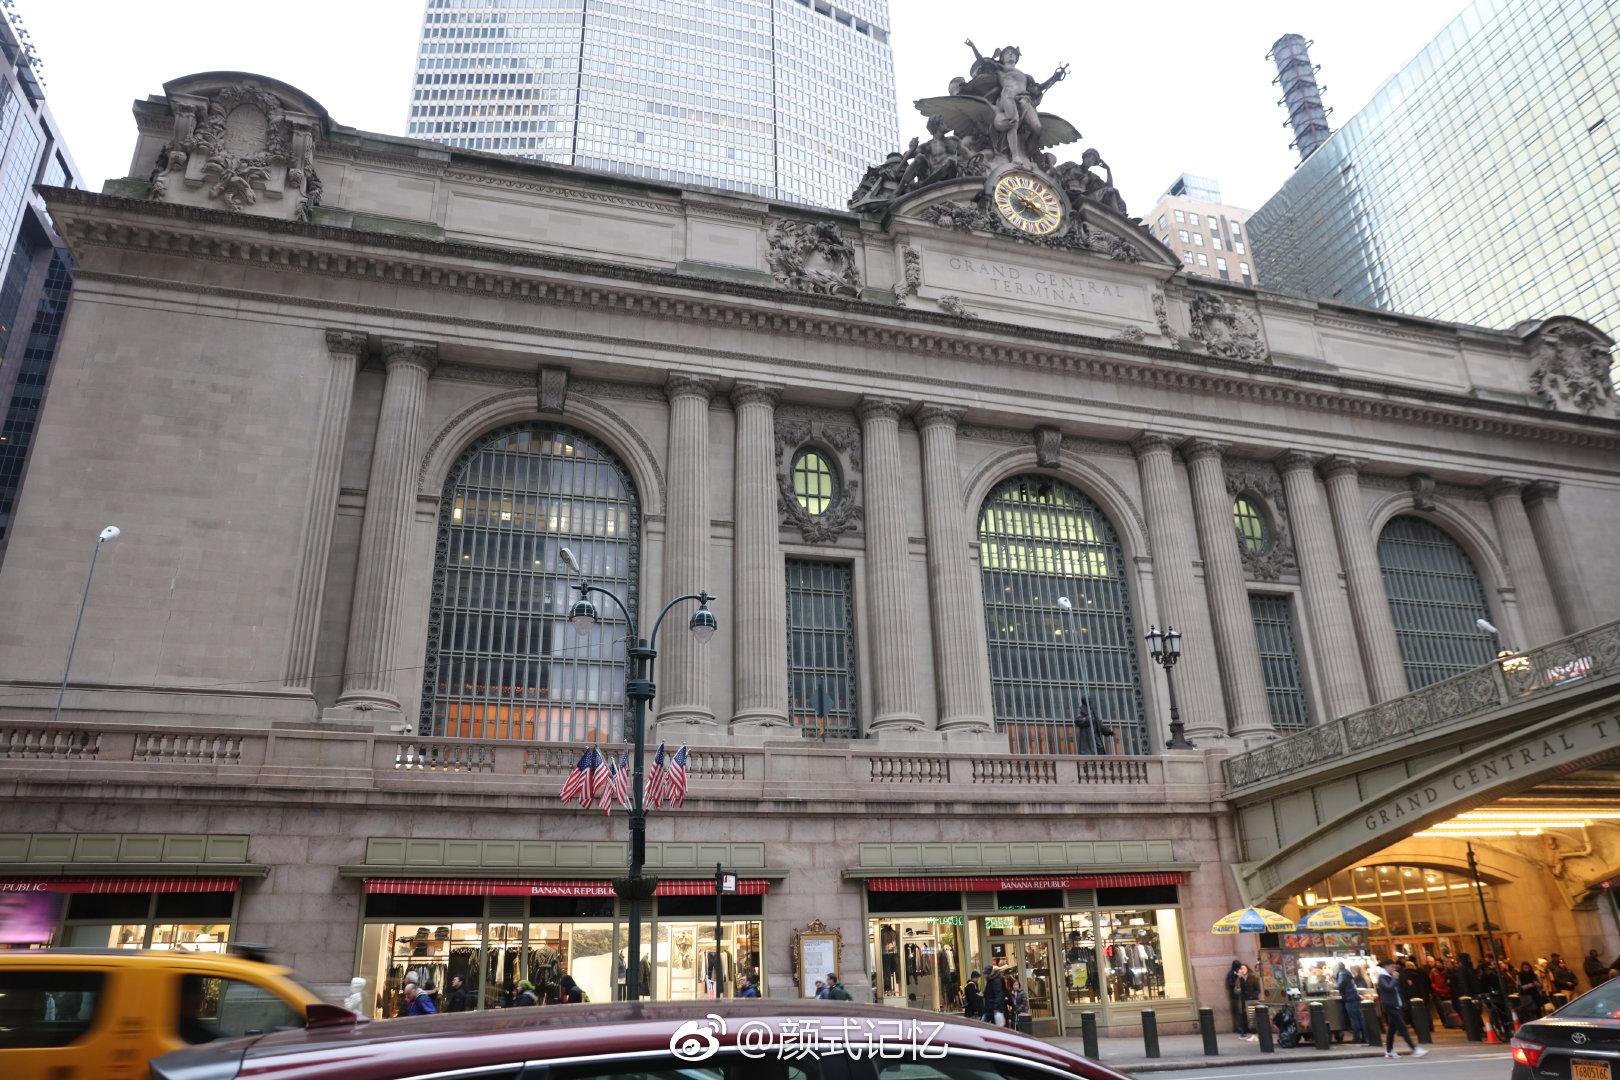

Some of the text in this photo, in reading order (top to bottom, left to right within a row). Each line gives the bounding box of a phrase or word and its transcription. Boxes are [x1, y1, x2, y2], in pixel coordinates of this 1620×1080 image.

[950, 258, 1124, 298] GRAND CENTRAL
[990, 278, 1090, 306] TERMINAL
[1365, 787, 1438, 831] GRAND
[1452, 734, 1574, 791] CENTRAL
[531, 886, 572, 895] BANANA
[1001, 880, 1070, 889] BANANA REPUBLIC
